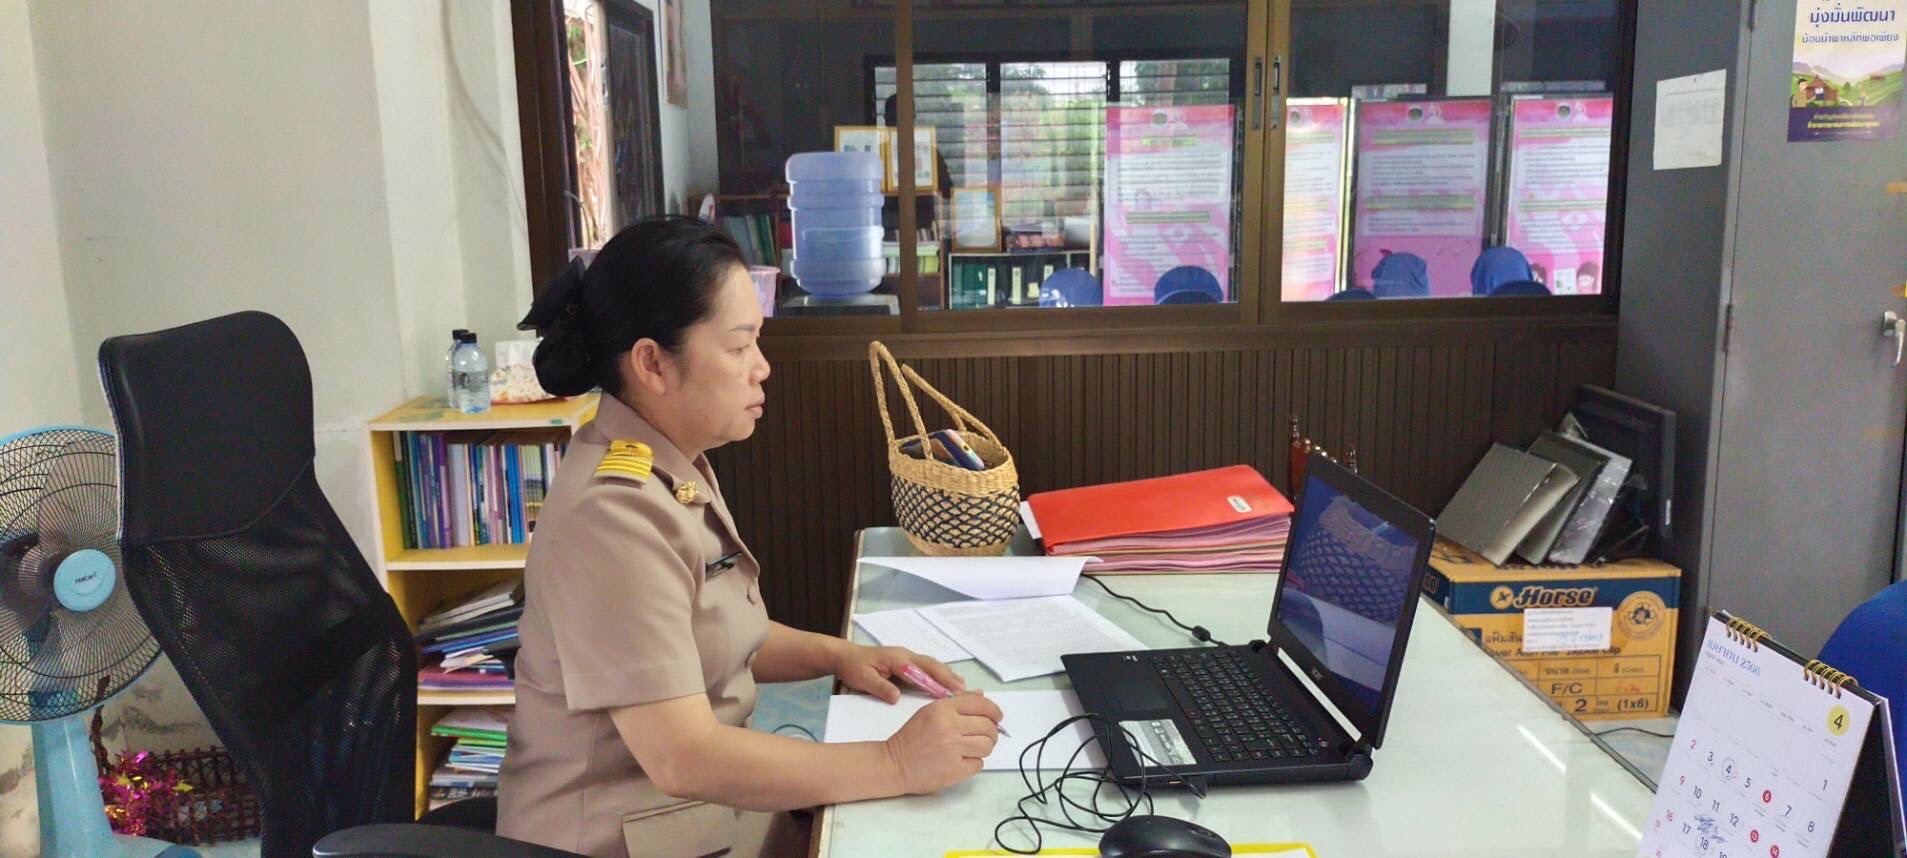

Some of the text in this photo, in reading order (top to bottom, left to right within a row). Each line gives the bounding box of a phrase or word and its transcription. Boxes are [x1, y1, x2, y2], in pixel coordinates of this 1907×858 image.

[1810, 3, 1895, 27] มุ่งมั่นพัฒนา
[1513, 586, 1594, 608] Horse
[1551, 682, 1583, 694] F/C
[1575, 698, 1587, 712] 2
[1617, 698, 1649, 712] (1x6)
[1833, 714, 1844, 730] 4
[1690, 739, 1696, 750] 2
[1708, 751, 1714, 762] 3
[1744, 778, 1751, 788] 5
[1785, 804, 1792, 816] 7
[1807, 821, 1815, 833] 8
[1693, 785, 1702, 799] 10
[1712, 800, 1720, 812] 11
[1730, 813, 1739, 827] 12
[1666, 809, 1674, 822] 16
[1683, 823, 1691, 835] 17
[1700, 836, 1709, 850] 18
